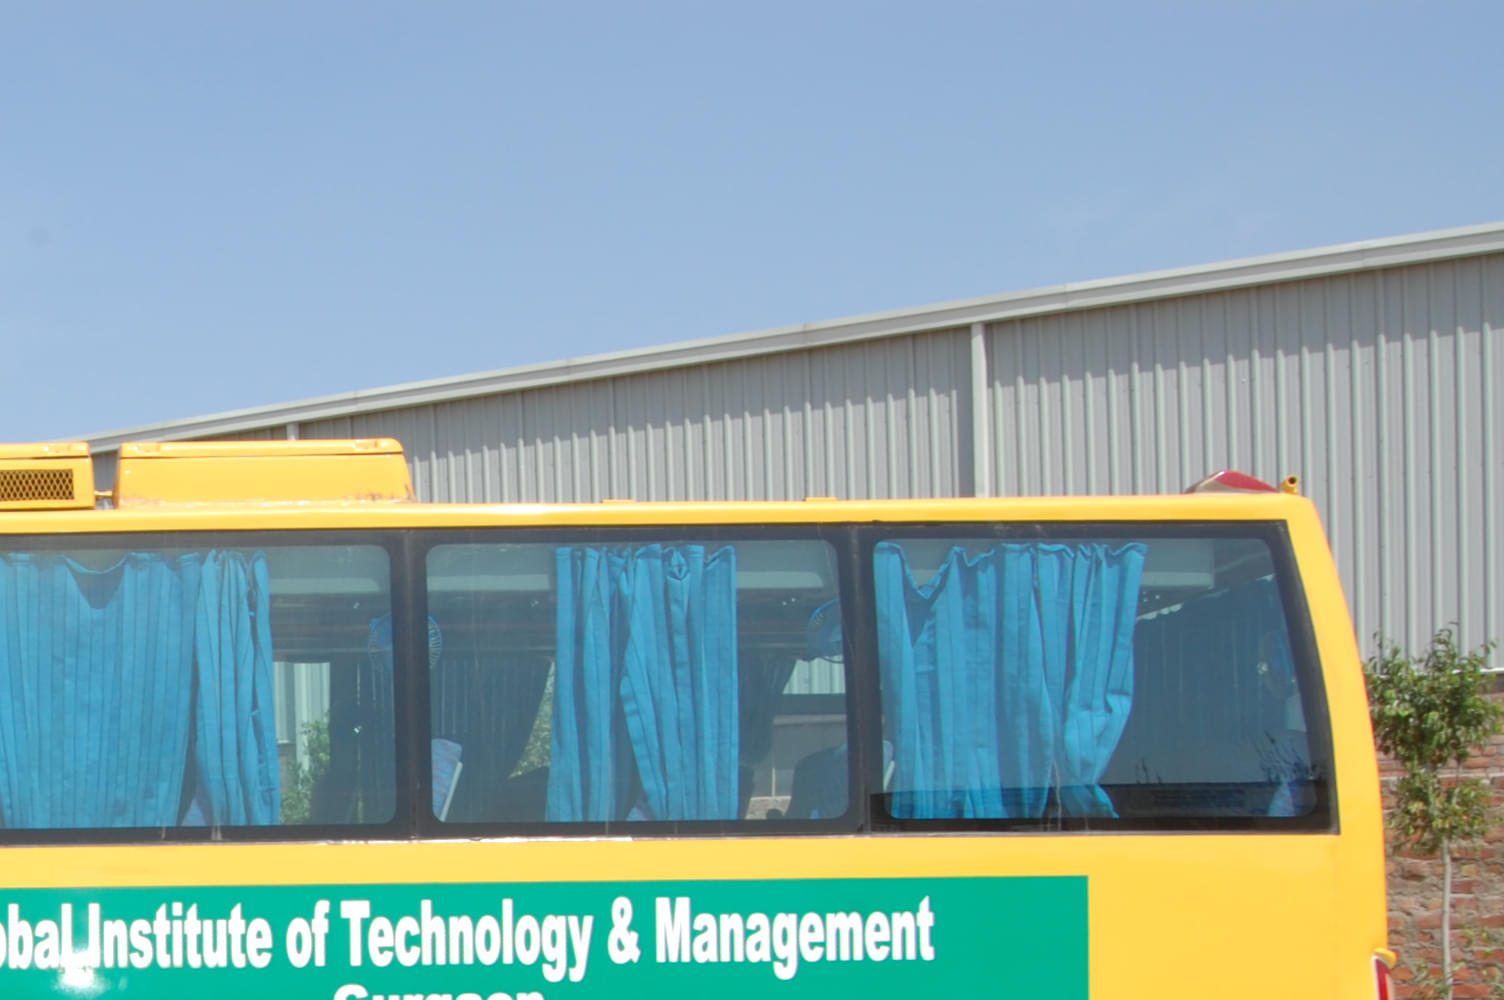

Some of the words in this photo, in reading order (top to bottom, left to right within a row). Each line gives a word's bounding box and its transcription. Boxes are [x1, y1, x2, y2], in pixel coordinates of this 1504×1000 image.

[87, 902, 273, 969] Institute
[286, 899, 331, 968] of
[340, 898, 594, 983] Technology
[607, 896, 641, 964] &
[655, 895, 935, 980] Management
